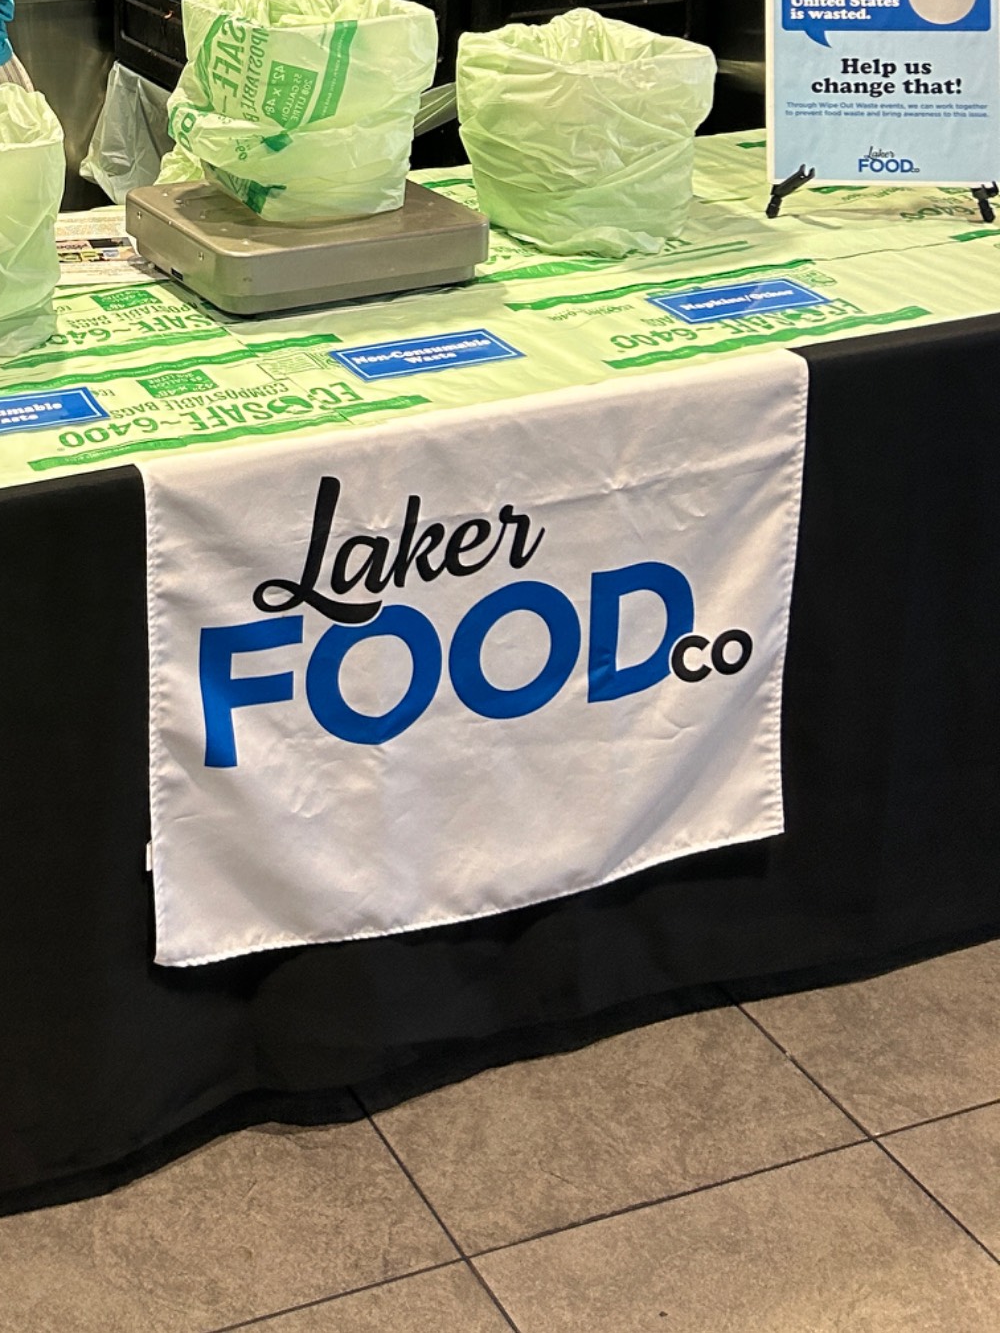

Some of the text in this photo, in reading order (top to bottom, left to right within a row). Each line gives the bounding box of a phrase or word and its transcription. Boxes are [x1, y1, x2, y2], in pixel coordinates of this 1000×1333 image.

[790, 8, 872, 20] is wasted.
[841, 58, 932, 78] Help us
[811, 77, 962, 98] change that!
[864, 146, 895, 160] Laker
[858, 158, 913, 173] FOOD
[352, 338, 492, 365] Non-Consumable
[402, 352, 457, 364] Waste
[253, 476, 545, 624] Laker
[199, 561, 694, 768] FOOD
